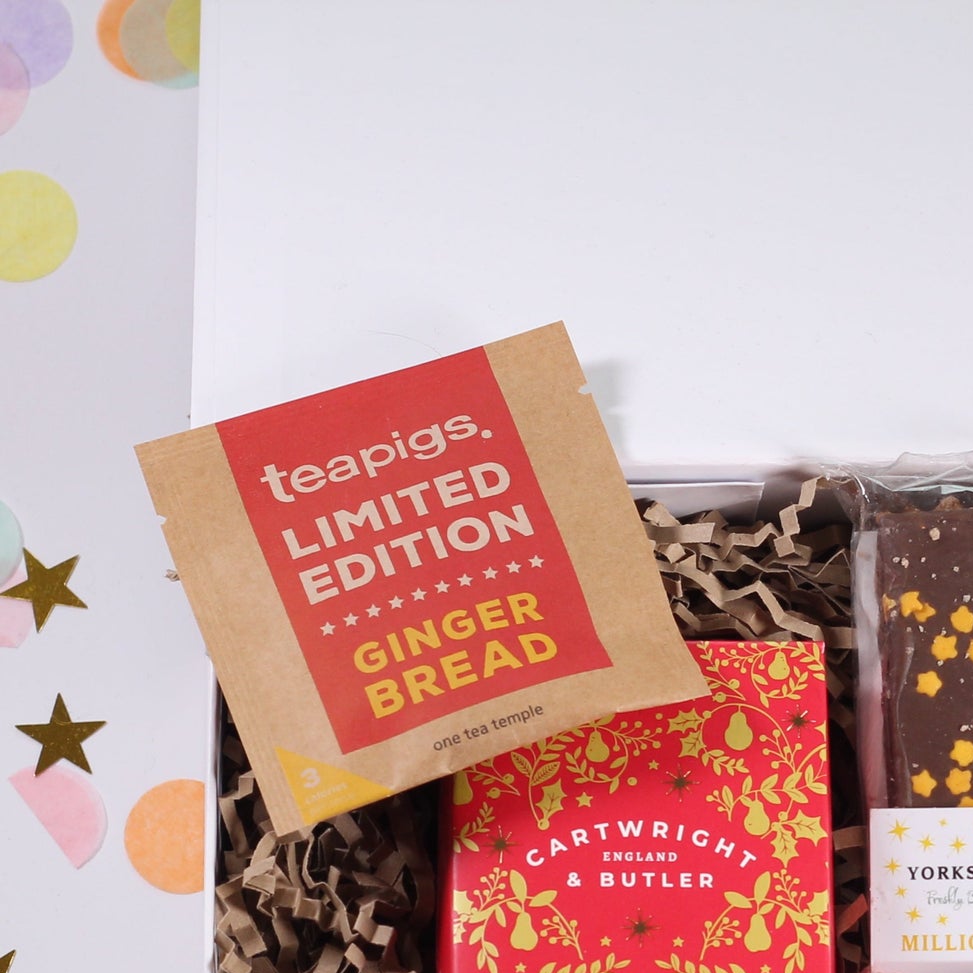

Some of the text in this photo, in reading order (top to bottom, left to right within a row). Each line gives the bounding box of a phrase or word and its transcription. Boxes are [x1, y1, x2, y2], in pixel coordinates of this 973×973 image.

[260, 414, 493, 502] teapigs.
[281, 461, 511, 560] LIMITED
[298, 504, 534, 605] EDITION
[353, 591, 544, 674] GINGER
[364, 632, 558, 719] BREAD
[433, 705, 544, 751] one tea temple
[300, 767, 320, 788] 3
[526, 820, 758, 870] CARTWRIGHT
[602, 851, 678, 862] ENGLAND
[566, 872, 714, 889] & BUTLER
